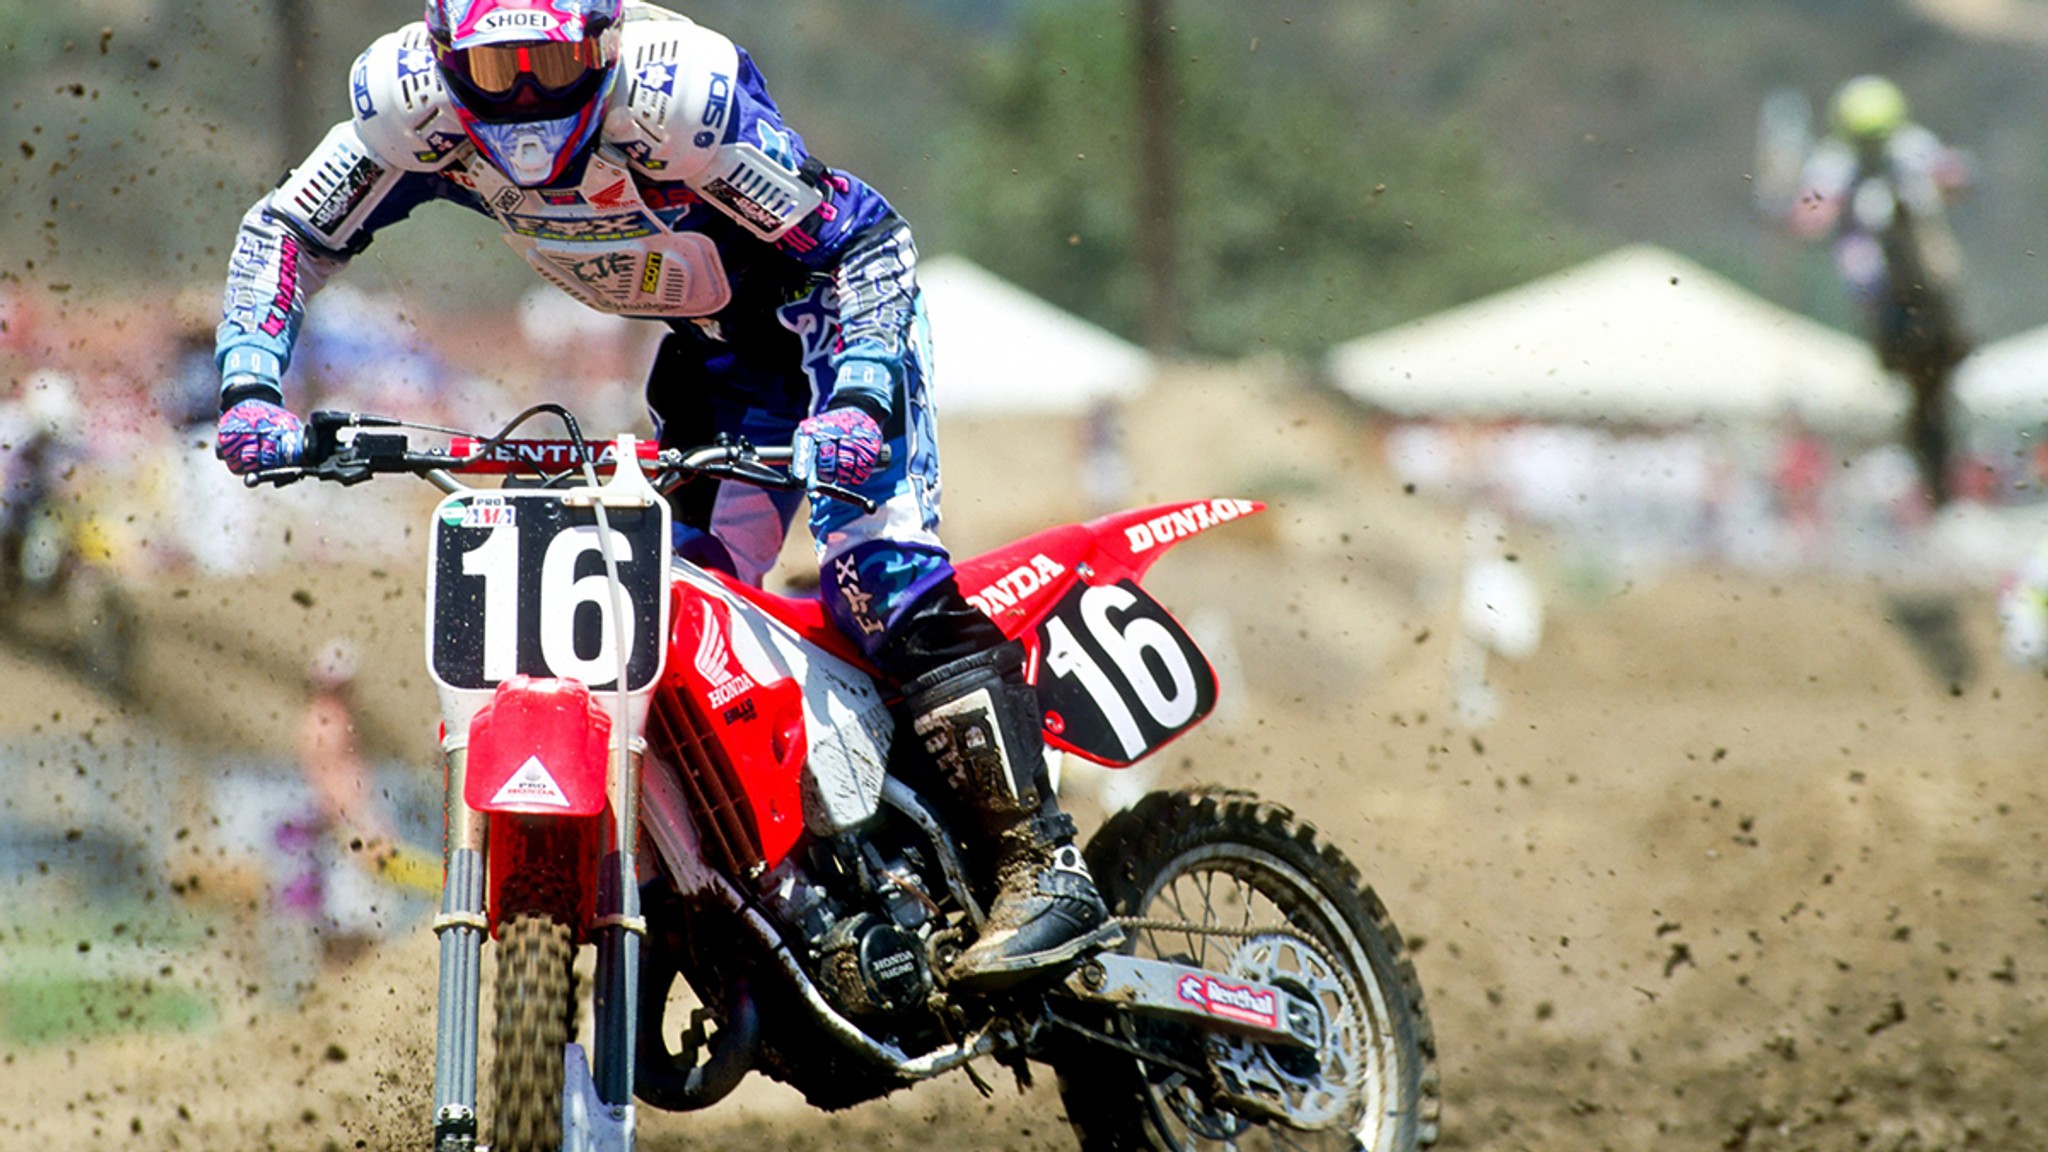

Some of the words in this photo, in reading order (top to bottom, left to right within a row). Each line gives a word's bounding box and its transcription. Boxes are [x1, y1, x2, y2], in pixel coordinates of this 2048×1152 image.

[486, 13, 548, 29] SHOEI
[702, 71, 730, 130] SIDI
[515, 228, 651, 241] RACING
[641, 253, 662, 294] SCOTT
[469, 442, 618, 463] RENTHA
[476, 498, 502, 506] PRO
[465, 508, 512, 524] AMA
[965, 553, 1066, 618] ONDA
[462, 525, 636, 686] 16
[1045, 584, 1198, 761] 16
[707, 673, 755, 709] HONDA
[506, 788, 557, 797] HONDA
[518, 781, 548, 789] PRO
[872, 950, 915, 972] HONDA
[1206, 979, 1274, 1015] Renthal
